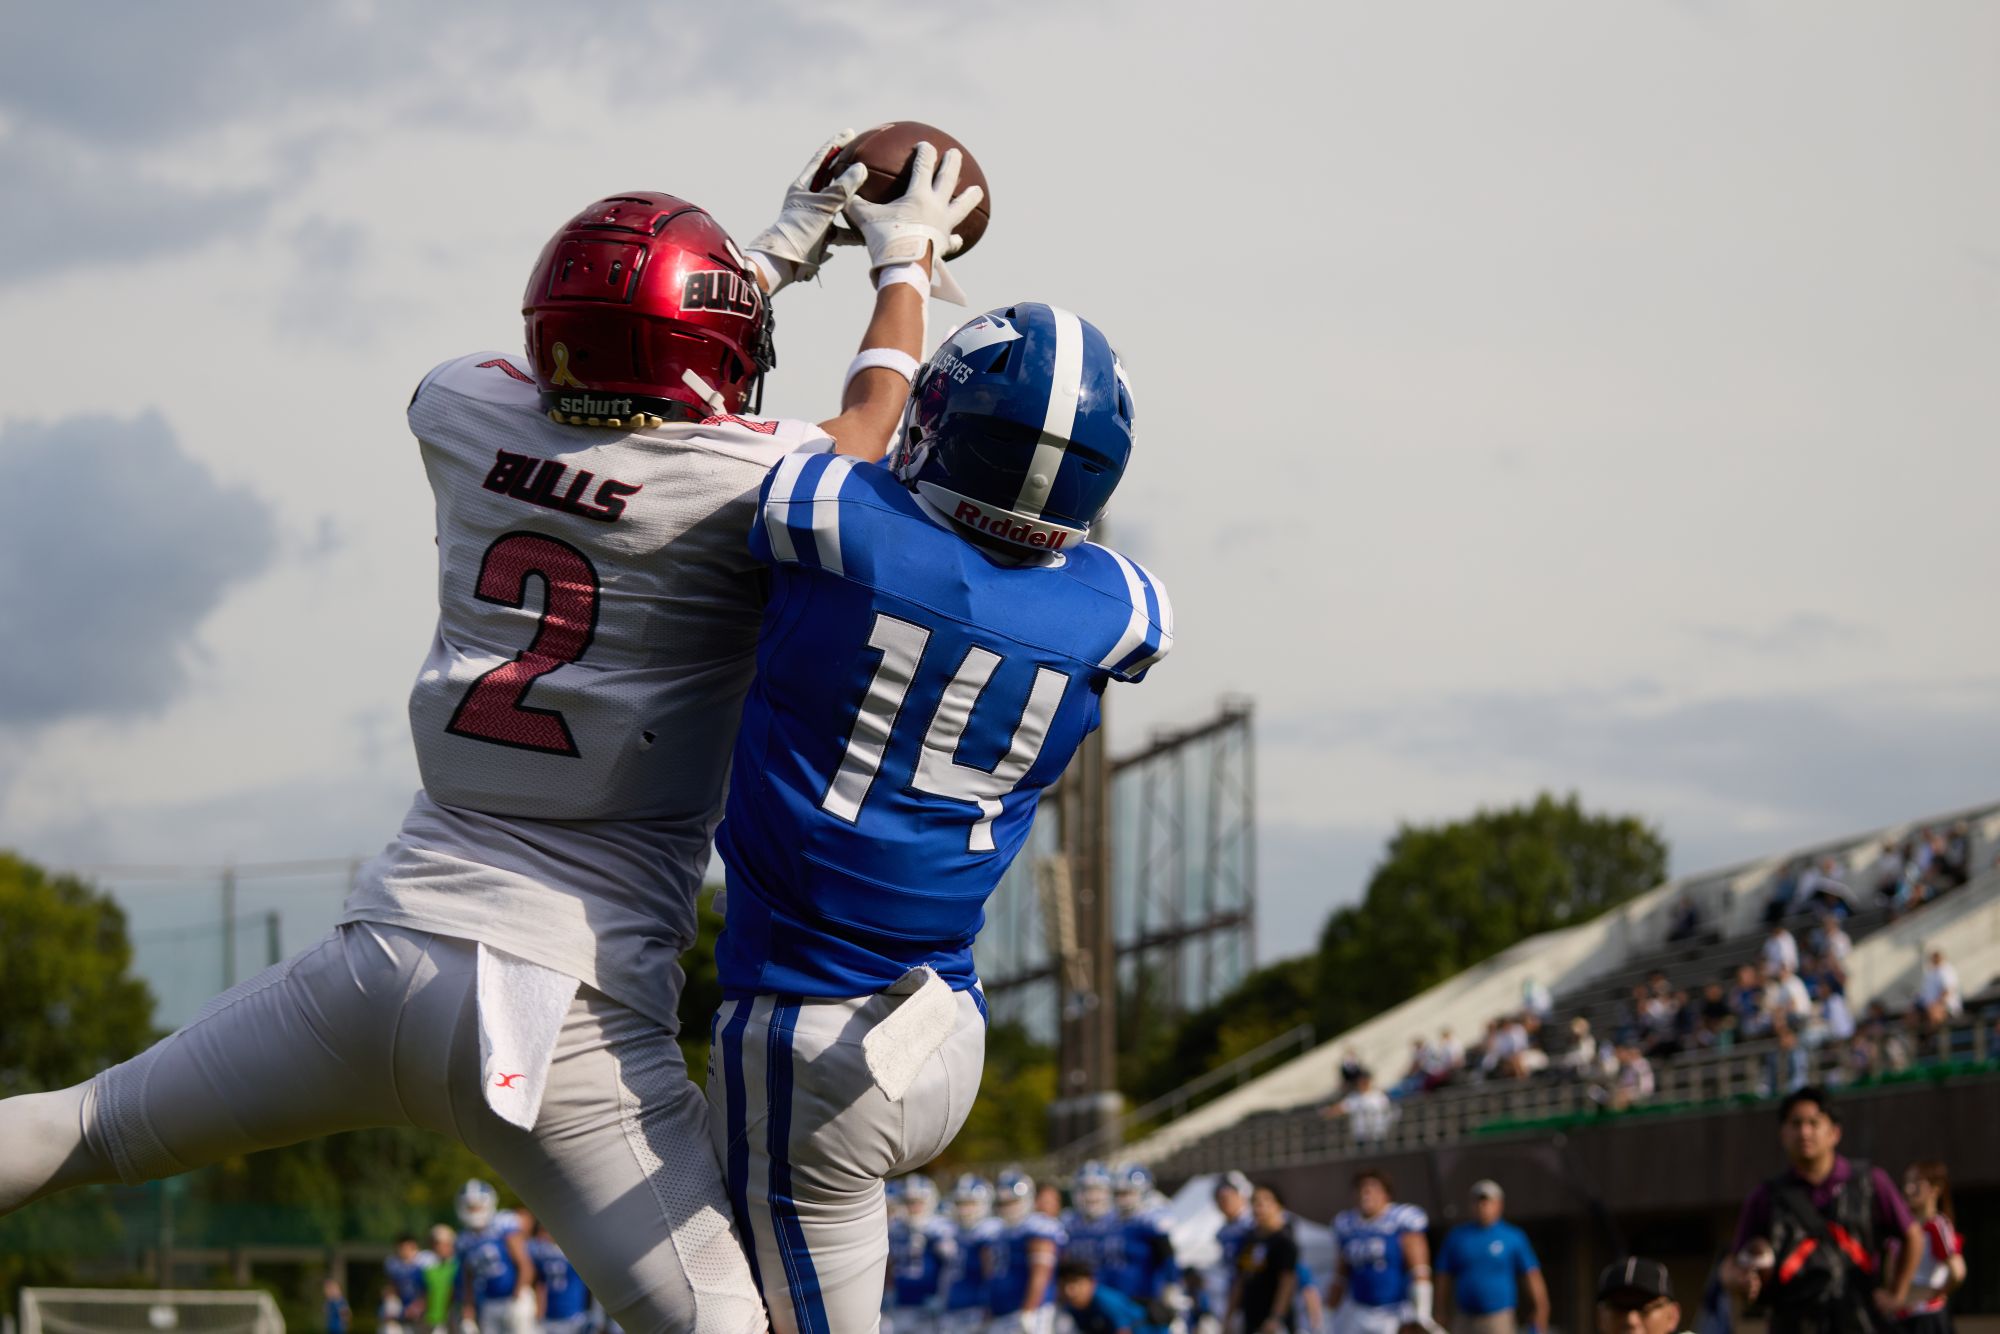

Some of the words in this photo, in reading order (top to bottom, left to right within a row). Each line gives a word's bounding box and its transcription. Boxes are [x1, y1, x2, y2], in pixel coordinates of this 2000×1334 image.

[560, 394, 632, 415] schutt
[482, 448, 643, 522] BULLS
[954, 500, 1068, 550] Riddell
[445, 530, 600, 758] 2
[817, 610, 1071, 854] 14
